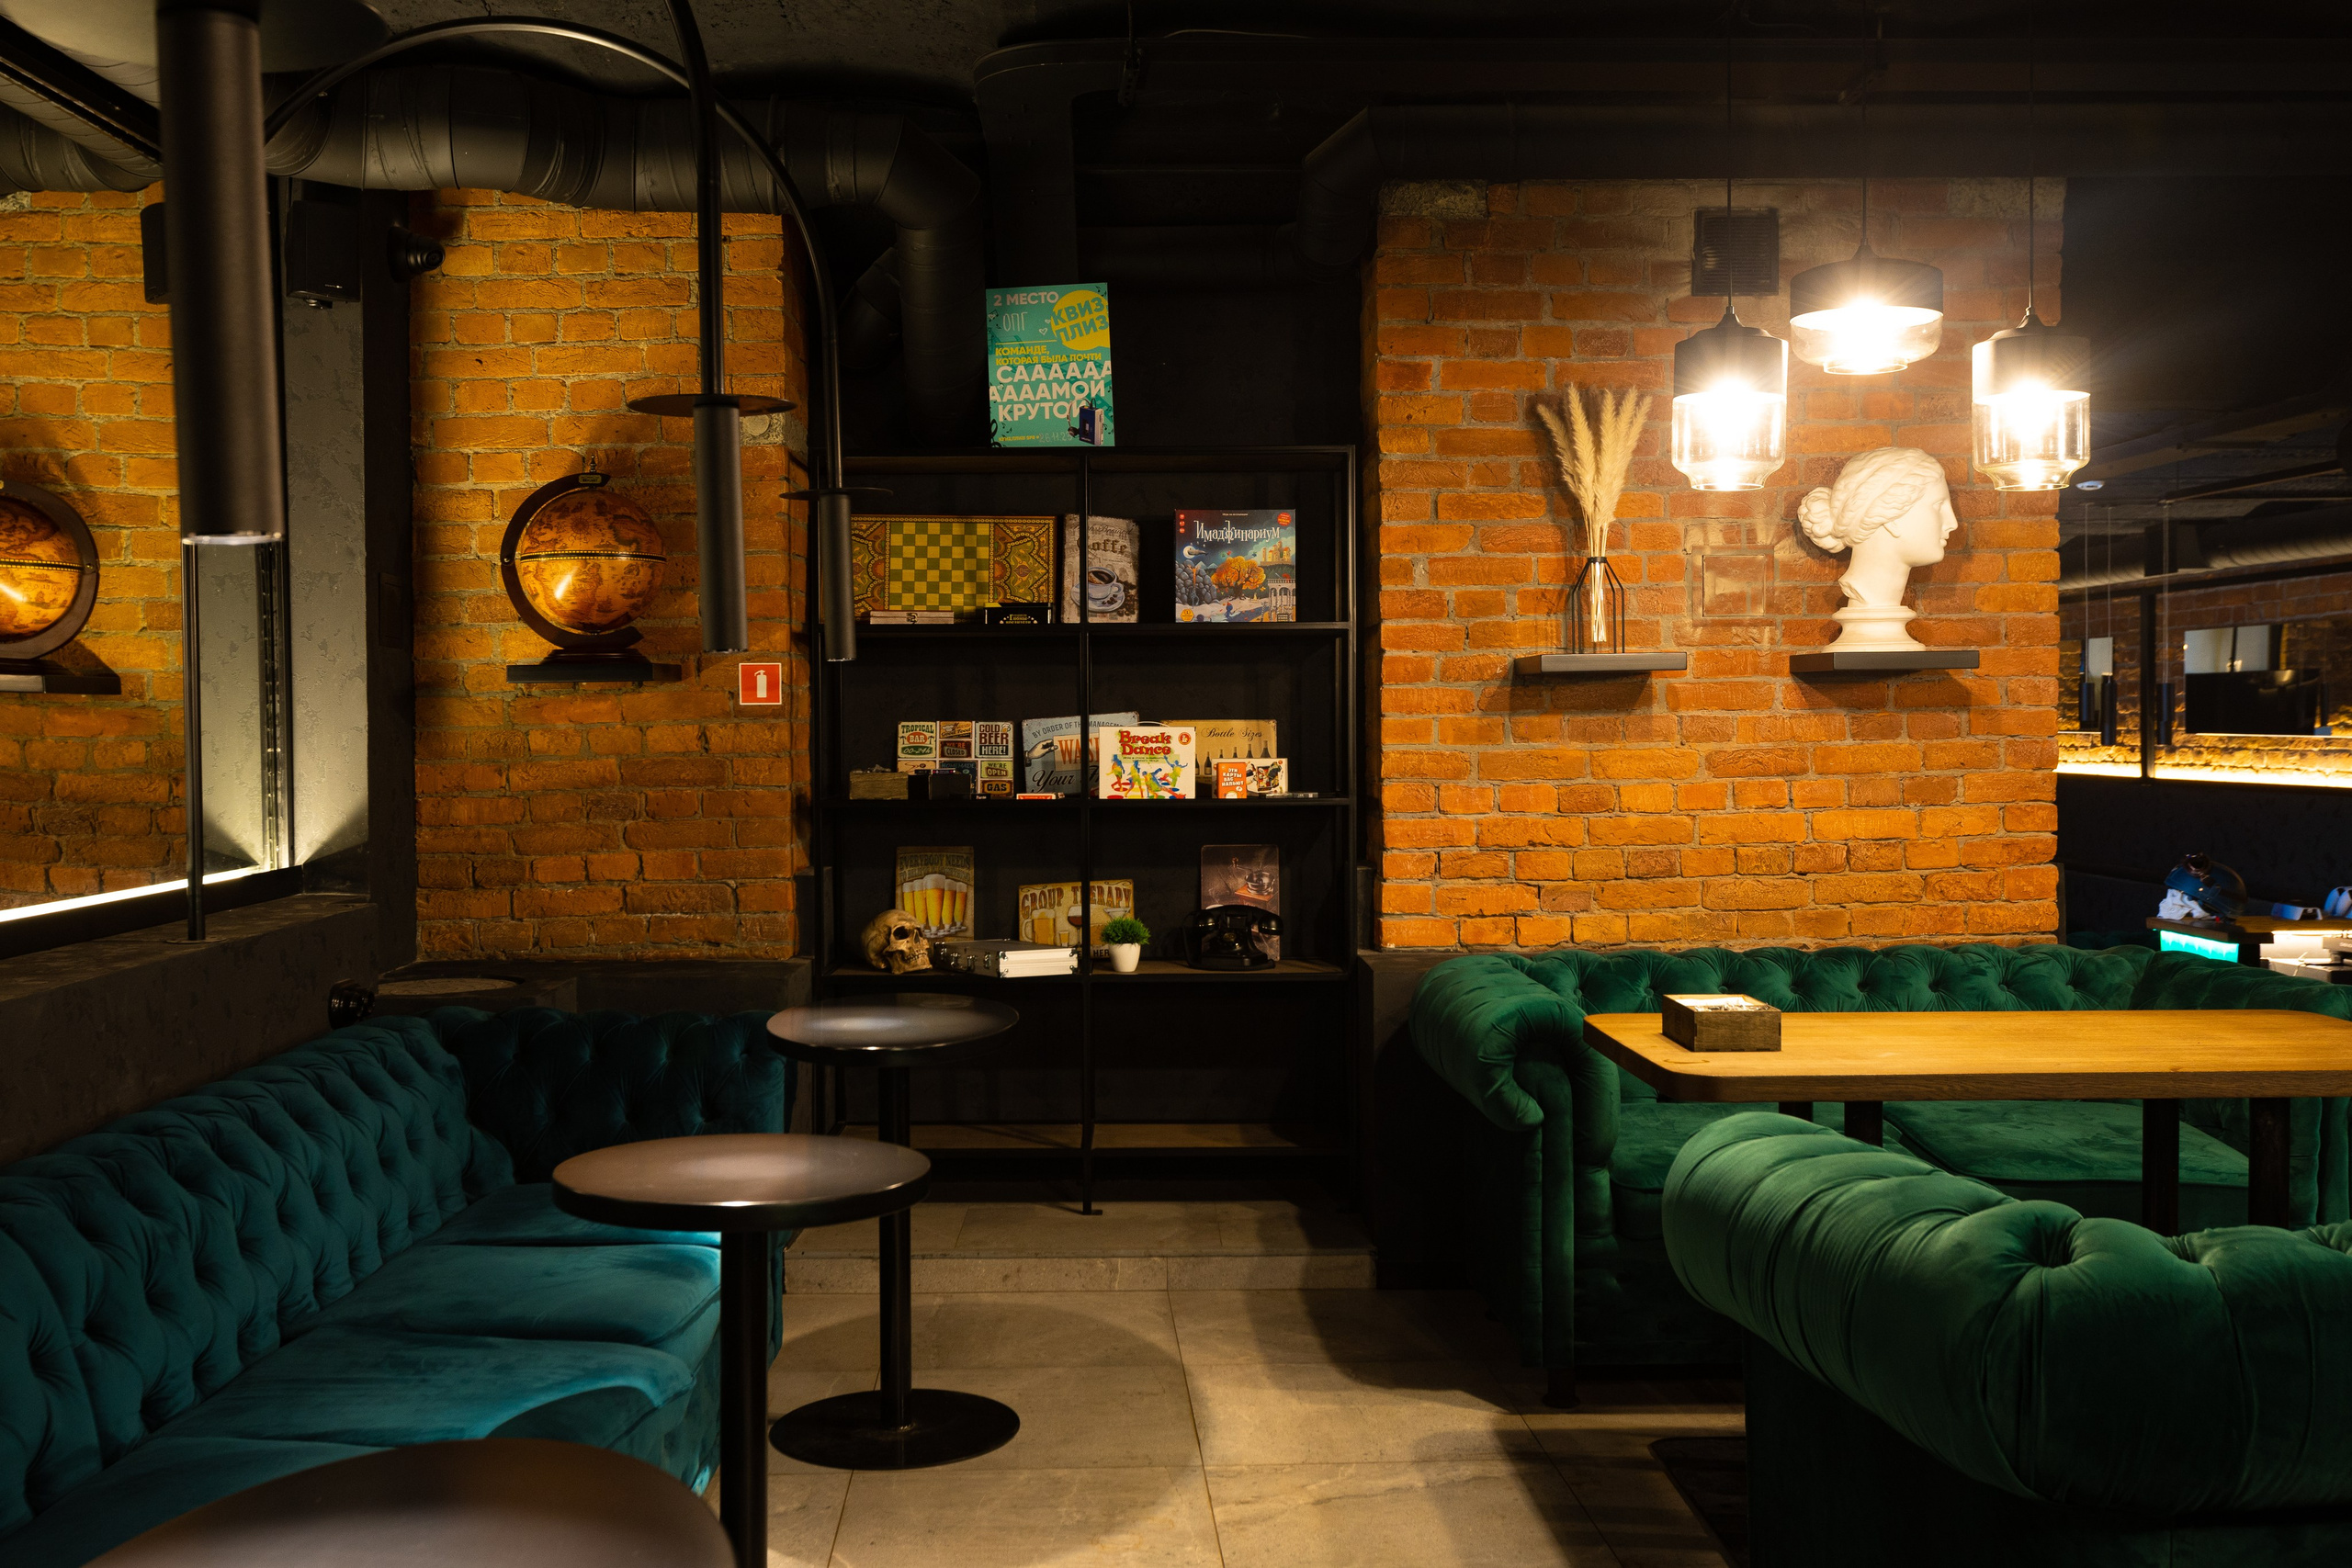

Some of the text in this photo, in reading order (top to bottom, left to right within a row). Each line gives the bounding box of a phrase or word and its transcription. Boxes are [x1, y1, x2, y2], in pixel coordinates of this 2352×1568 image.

[994, 291, 1059, 307] 2 МЕСТО
[1054, 315, 1109, 343] ПЛИЗ
[995, 344, 1050, 356] КОМАНДЕ,
[995, 352, 1102, 367] КОТОРАЯ БЫЛА ПОЧТИ
[1193, 520, 1281, 544] Имаджинариум
[901, 724, 934, 734] TROPICAL
[979, 724, 1001, 733] COLD
[1032, 729, 1041, 739] BY
[1042, 724, 1063, 735] ORDER
[1200, 728, 1263, 741] Bottle Sizes
[909, 735, 925, 743] BAR
[979, 733, 1009, 745] BEER
[1119, 730, 1171, 745] Break
[946, 748, 966, 757] CLOSED
[981, 746, 1006, 756] HERE!
[1120, 743, 1171, 756] Dance
[987, 769, 1007, 777] OPEN
[987, 783, 1008, 792] GAS
[1032, 770, 1075, 793] Your
[899, 853, 970, 872] EVERYBODY NEEDS
[1021, 885, 1131, 919] GROUP TERAPY
[1093, 949, 1110, 957] HER
